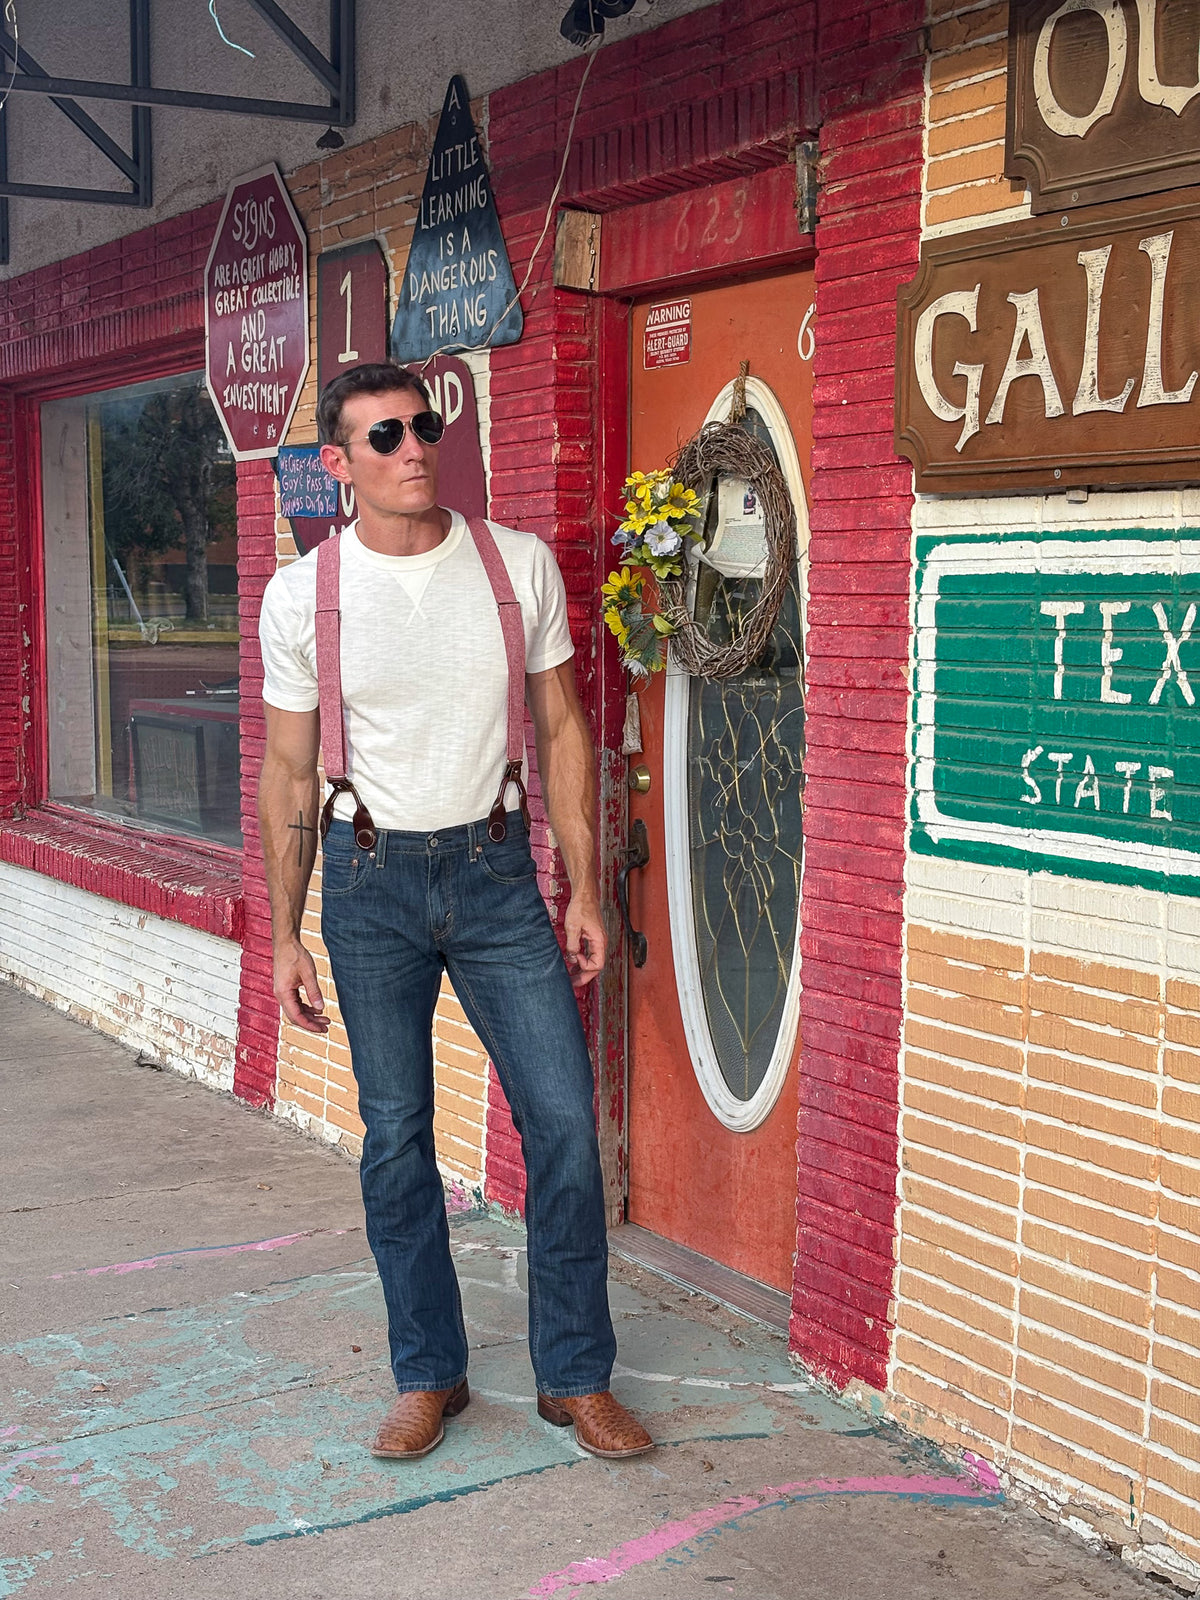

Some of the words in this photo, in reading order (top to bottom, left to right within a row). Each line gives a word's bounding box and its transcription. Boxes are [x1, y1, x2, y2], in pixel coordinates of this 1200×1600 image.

[448, 84, 461, 112] A
[431, 136, 480, 181] LITTLE
[421, 174, 487, 230] LEARNING
[675, 189, 746, 254] 623
[214, 264, 231, 288] ARE
[232, 261, 240, 285] A
[241, 253, 265, 285] GREAT
[269, 242, 298, 275] HOBBY,
[440, 232, 454, 261] IS
[462, 226, 472, 255] A
[215, 285, 250, 317] GREAT
[252, 272, 300, 308] COLLECTIBLE
[410, 250, 498, 304] DANGEROUS
[240, 310, 266, 343] AND
[338, 270, 359, 363] 1
[426, 294, 487, 338] THANG
[226, 342, 237, 377] A
[241, 335, 286, 374] GREAT
[914, 230, 1198, 453] GALL
[223, 382, 288, 416] INVESTMENT
[423, 371, 463, 426] ND
[306, 474, 322, 492] PASS
[1040, 600, 1197, 706] TEX
[1020, 745, 1174, 822] STATE
